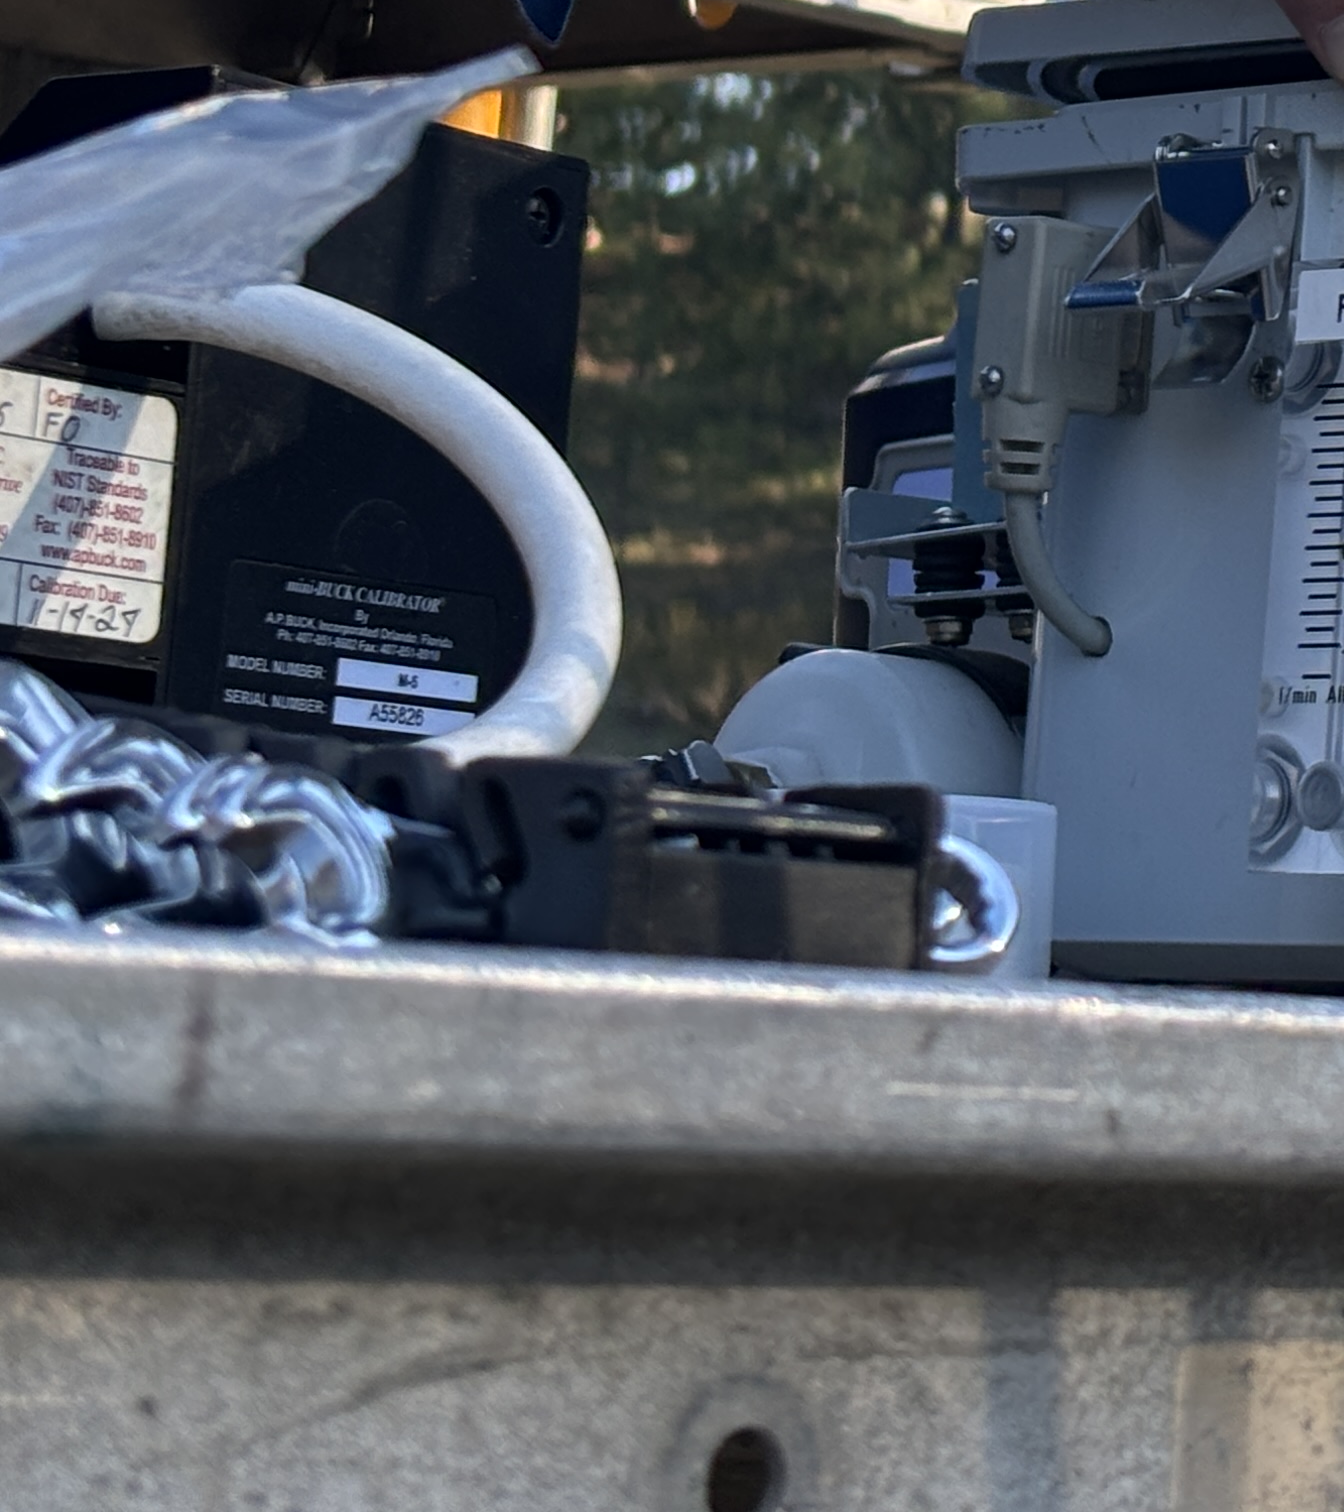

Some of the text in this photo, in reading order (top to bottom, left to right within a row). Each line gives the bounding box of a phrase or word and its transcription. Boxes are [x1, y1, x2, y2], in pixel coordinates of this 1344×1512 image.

[47, 388, 124, 420] Certified By:
[66, 447, 141, 475] Traceable to
[53, 469, 149, 501] NIST Standards
[41, 544, 147, 572] www.apbuck.com
[29, 574, 127, 605] Calibration Due:
[354, 609, 370, 624] By
[226, 653, 328, 680] MODEL NUMBER:
[223, 688, 328, 714] SERIAL NUMBER:
